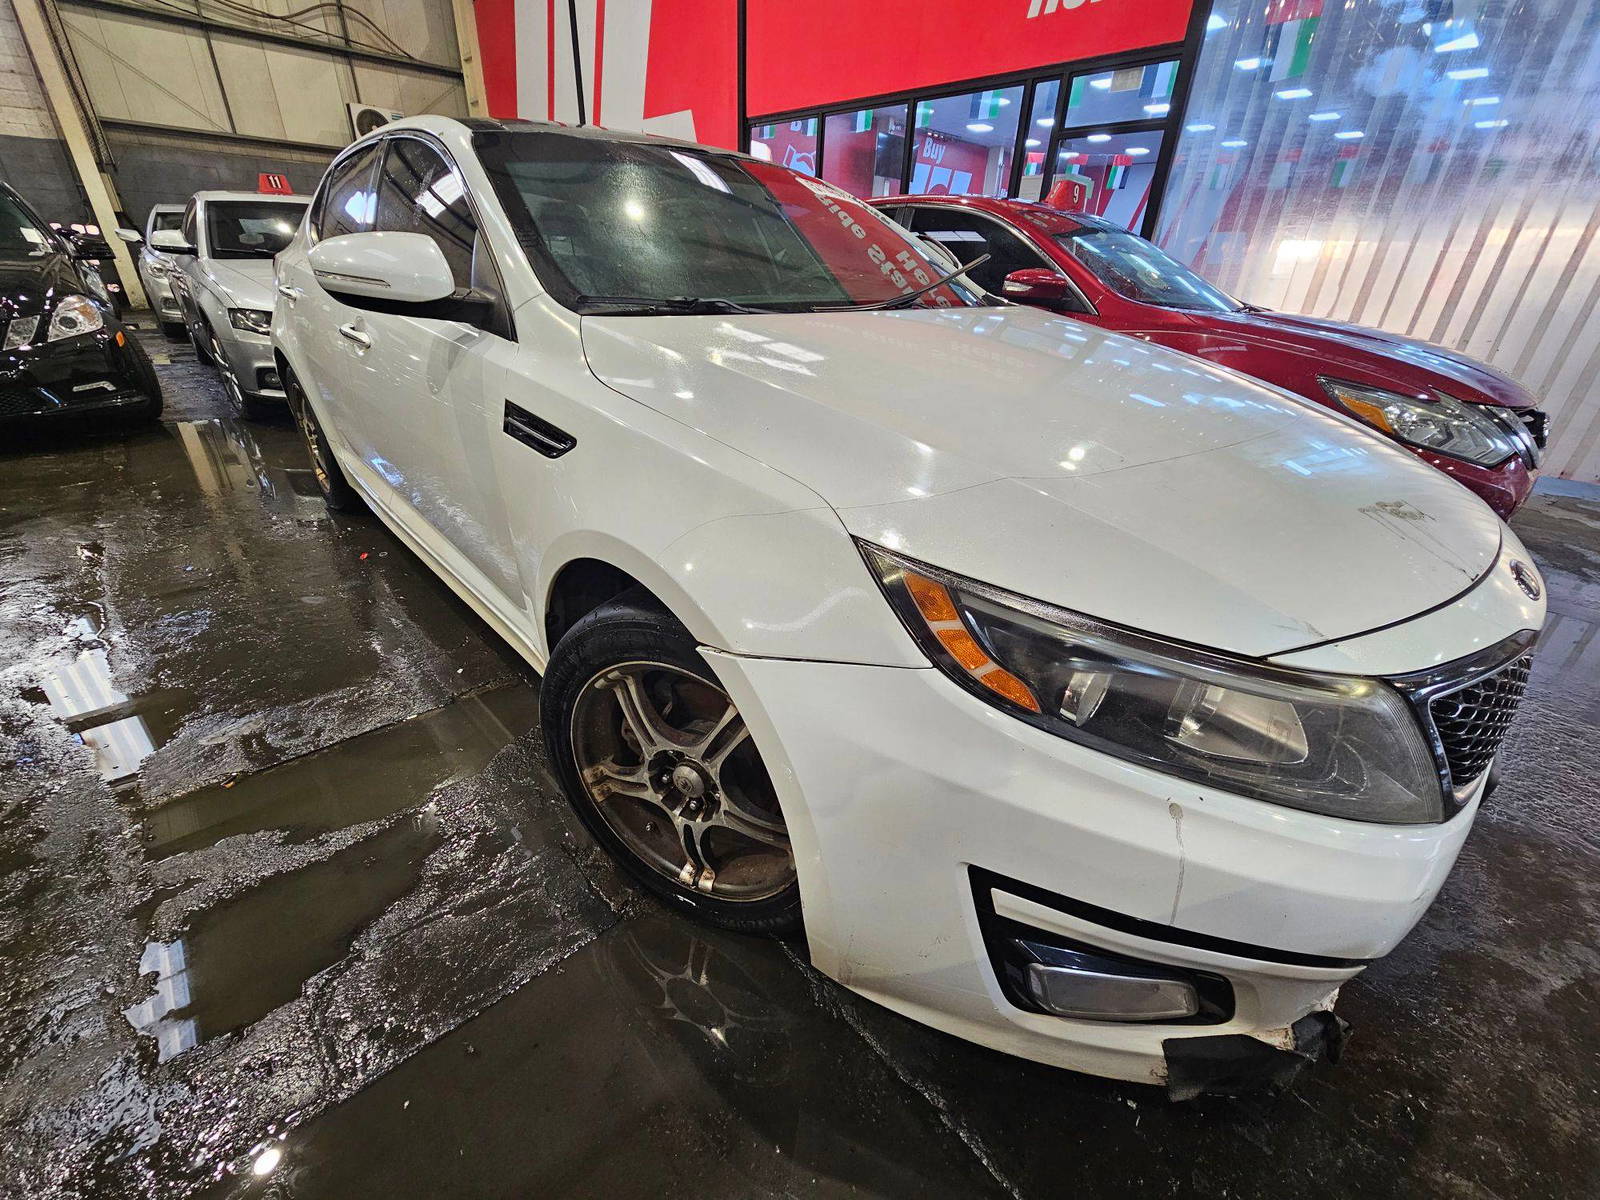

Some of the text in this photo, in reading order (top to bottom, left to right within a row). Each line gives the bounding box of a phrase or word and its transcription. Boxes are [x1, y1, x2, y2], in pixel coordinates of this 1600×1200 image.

[923, 137, 946, 164] Buy
[268, 175, 282, 189] 11
[1073, 184, 1081, 204] 9
